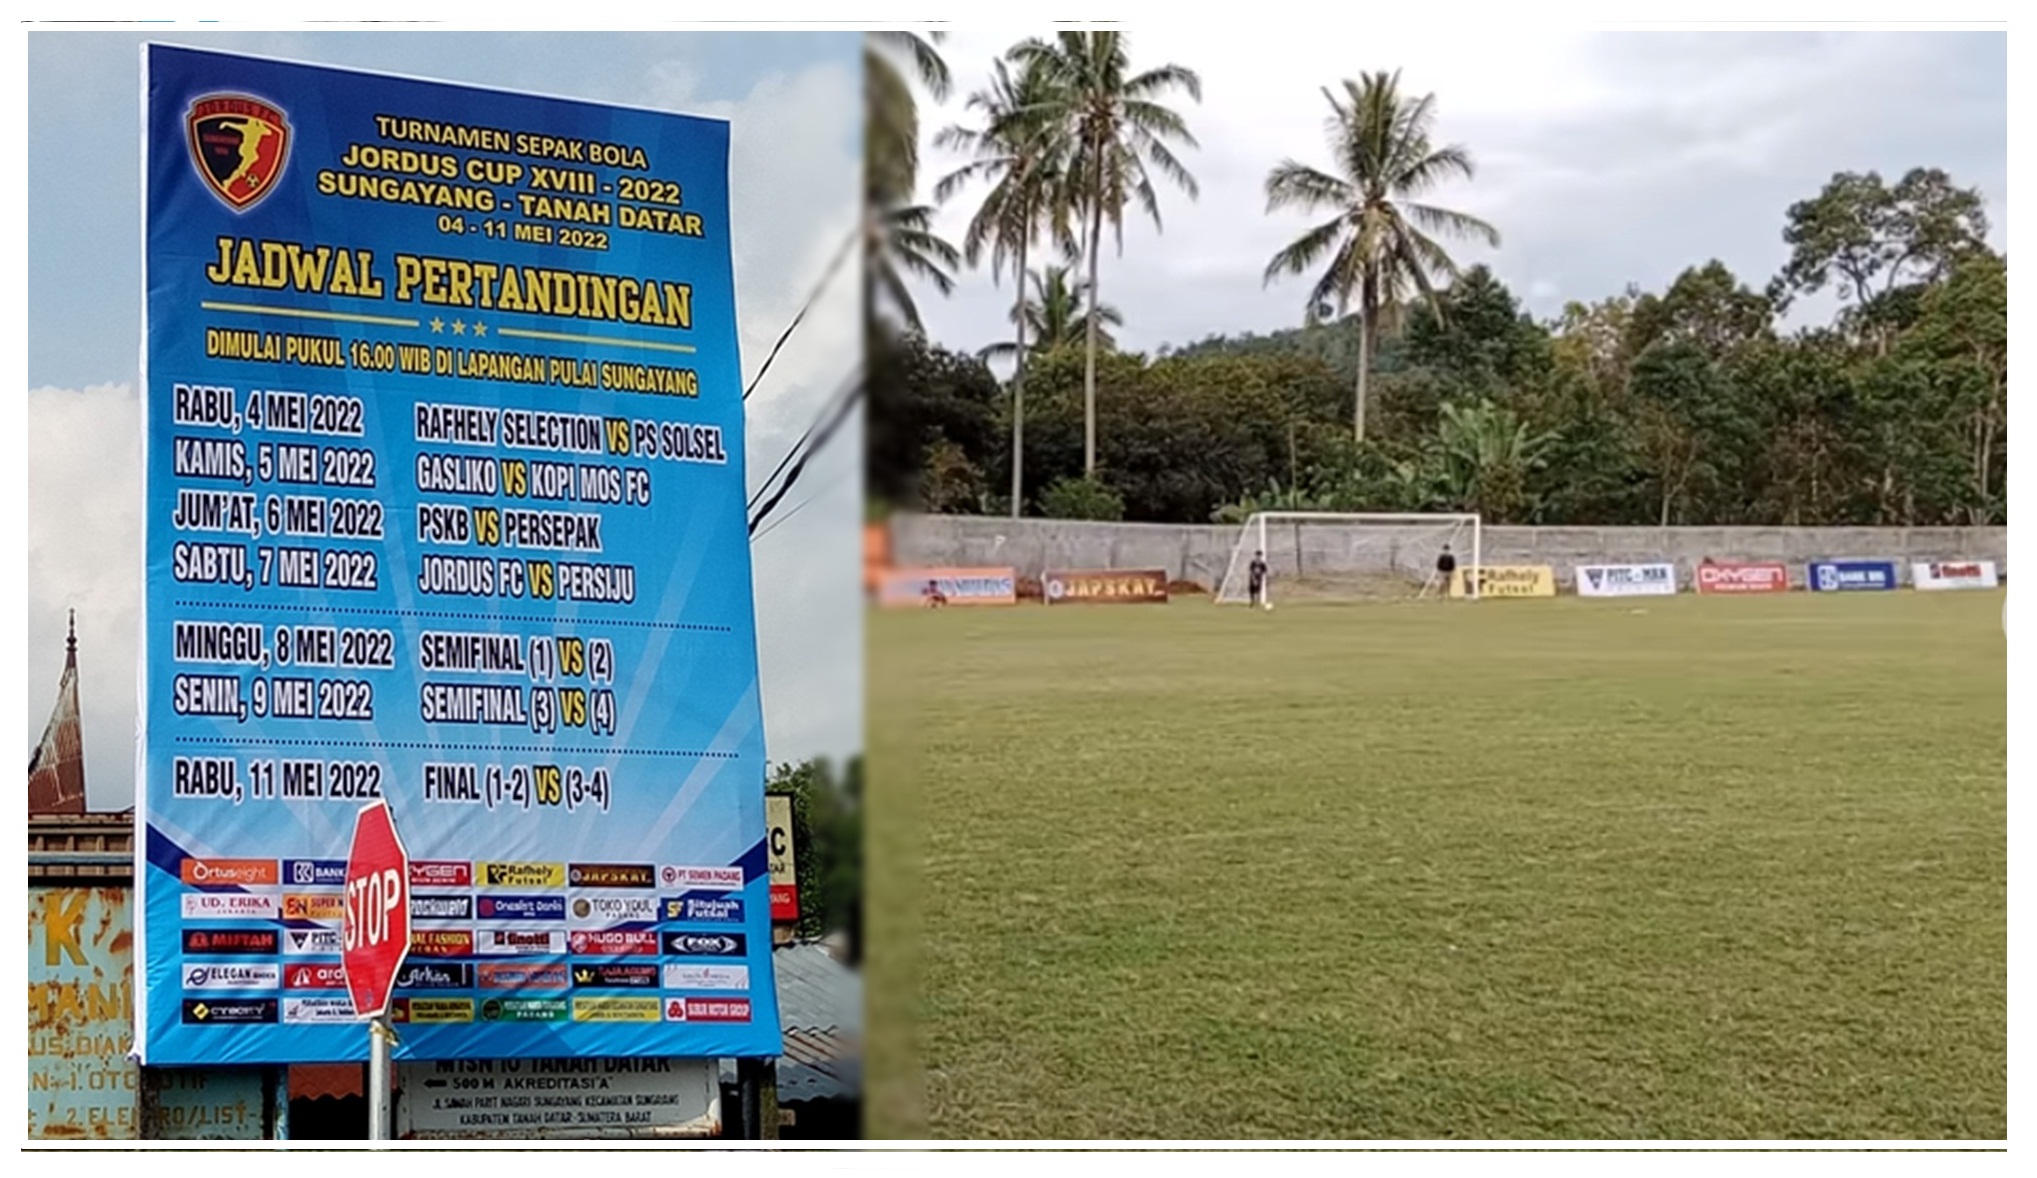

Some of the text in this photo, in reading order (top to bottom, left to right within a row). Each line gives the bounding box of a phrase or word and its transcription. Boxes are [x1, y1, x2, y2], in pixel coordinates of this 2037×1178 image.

[376, 116, 647, 169] TURNAMEN SEPAK BOLA
[343, 146, 458, 177] JORDUS
[467, 160, 522, 186] CUP
[531, 167, 595, 194] XVIII
[619, 179, 681, 204] 2022
[318, 172, 494, 212] SUNGAYANG
[519, 195, 610, 225] TANAH
[620, 208, 702, 236] DATAR
[438, 216, 464, 234] 04
[483, 222, 507, 239] 11
[515, 224, 552, 243] MEI
[559, 228, 607, 249] 2022
[208, 239, 692, 327] JADWAL PERTANDINGAN
[207, 330, 698, 397] DIMULAI PUKUL 16.00 WIB DI LAPANGAN PULAI SUNGAYANG
[175, 386, 363, 434] RABU, 4 MEI 2022
[416, 404, 725, 461] RAFHELY SELECTION VS PS SOLSEL
[175, 438, 375, 486] KAMIS, 5 MEI 2022
[417, 455, 649, 504] GASLIKO VS KOPI MOS FC
[266, 496, 280, 532] 6
[286, 498, 326, 534] MEI
[331, 501, 382, 538] 2022
[418, 506, 601, 550] PSKB VS PERSEPAK
[174, 543, 377, 588] SABTU, 7 MEI 2022
[419, 557, 634, 601] JORDUS FC VS PERSIJU
[1701, 567, 1783, 585] OXYGEN
[175, 624, 393, 668] MINGGU, 8 MEI 2022
[421, 633, 612, 682] SEMIFINAL (1) VS (2)
[175, 676, 372, 720] SENIN, 9 MEI 2022
[422, 685, 615, 734] SEMIFINAL (3) VS (4)
[175, 760, 381, 800] RABU, 11 MEI 2022
[424, 765, 609, 810] FINAL (1-2) VS (3-4)
[193, 861, 267, 883] Ortuseight
[229, 897, 271, 908] ERIKA
[345, 867, 401, 952] STOP
[212, 934, 273, 947] MIFTAH
[626, 934, 656, 944] BULL
[687, 937, 722, 948] FOX
[453, 1077, 480, 1090] 500
[503, 1076, 595, 1090] AKREDITASI
